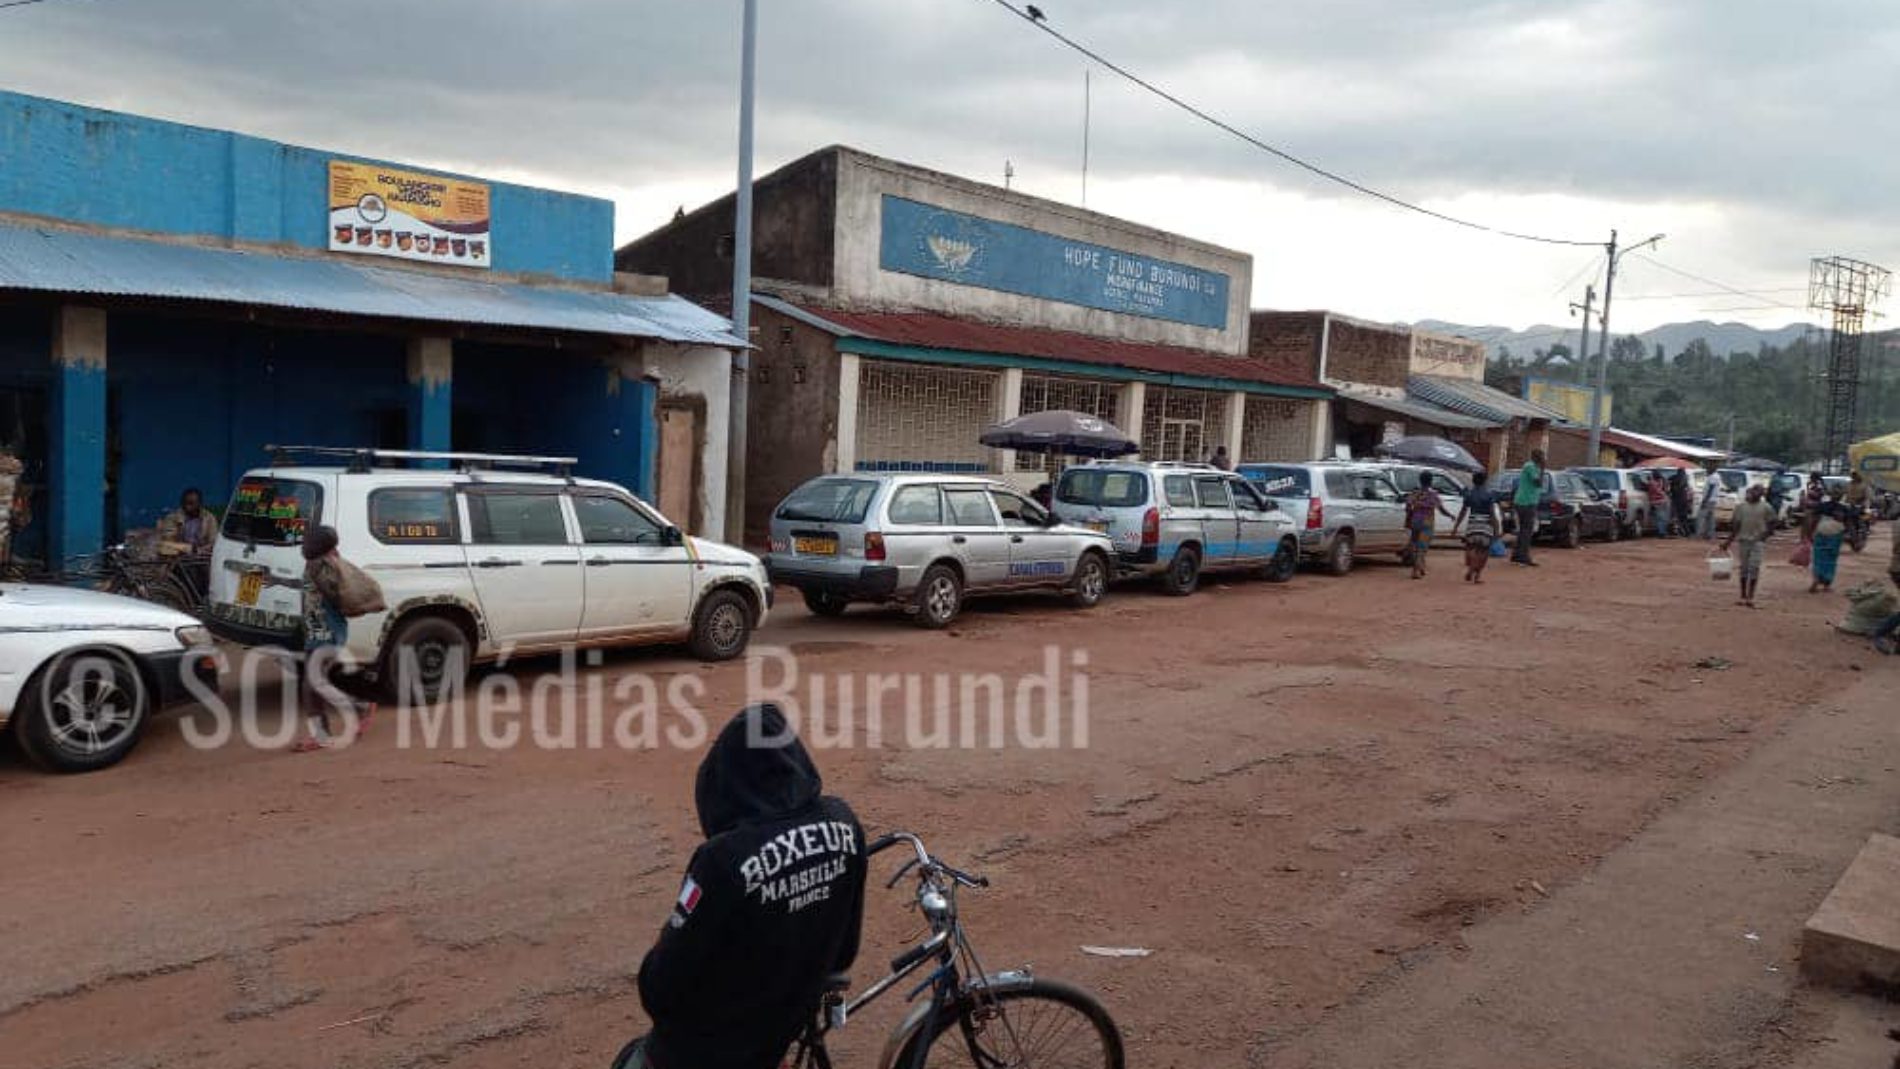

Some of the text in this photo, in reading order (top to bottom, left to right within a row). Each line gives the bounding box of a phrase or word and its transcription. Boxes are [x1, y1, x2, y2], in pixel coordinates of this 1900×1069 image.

[1064, 246, 1099, 270] HOPE
[1109, 255, 1143, 279] FUND
[1151, 266, 1200, 293] BURUNDI
[740, 821, 857, 893] BOXEUR
